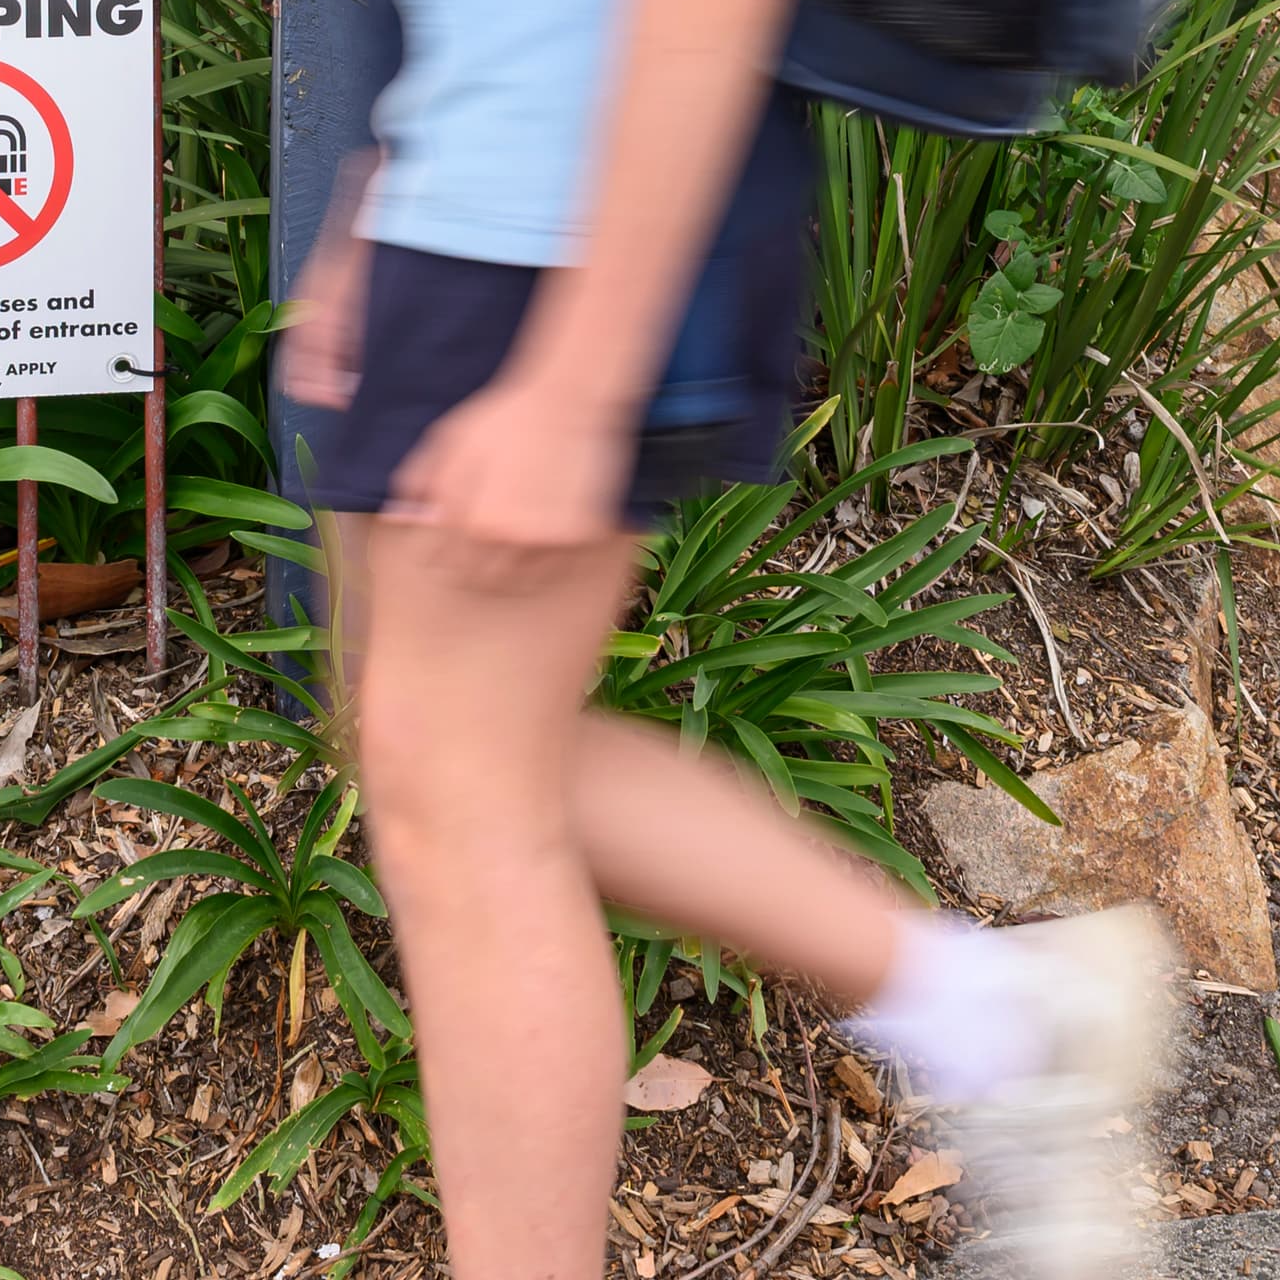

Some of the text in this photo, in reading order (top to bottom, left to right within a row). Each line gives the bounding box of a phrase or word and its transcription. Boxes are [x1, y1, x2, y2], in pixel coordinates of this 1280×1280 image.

[14, 177, 28, 197] E
[46, 288, 95, 311] and
[28, 321, 139, 340] entrance
[5, 360, 58, 377] APPLY
